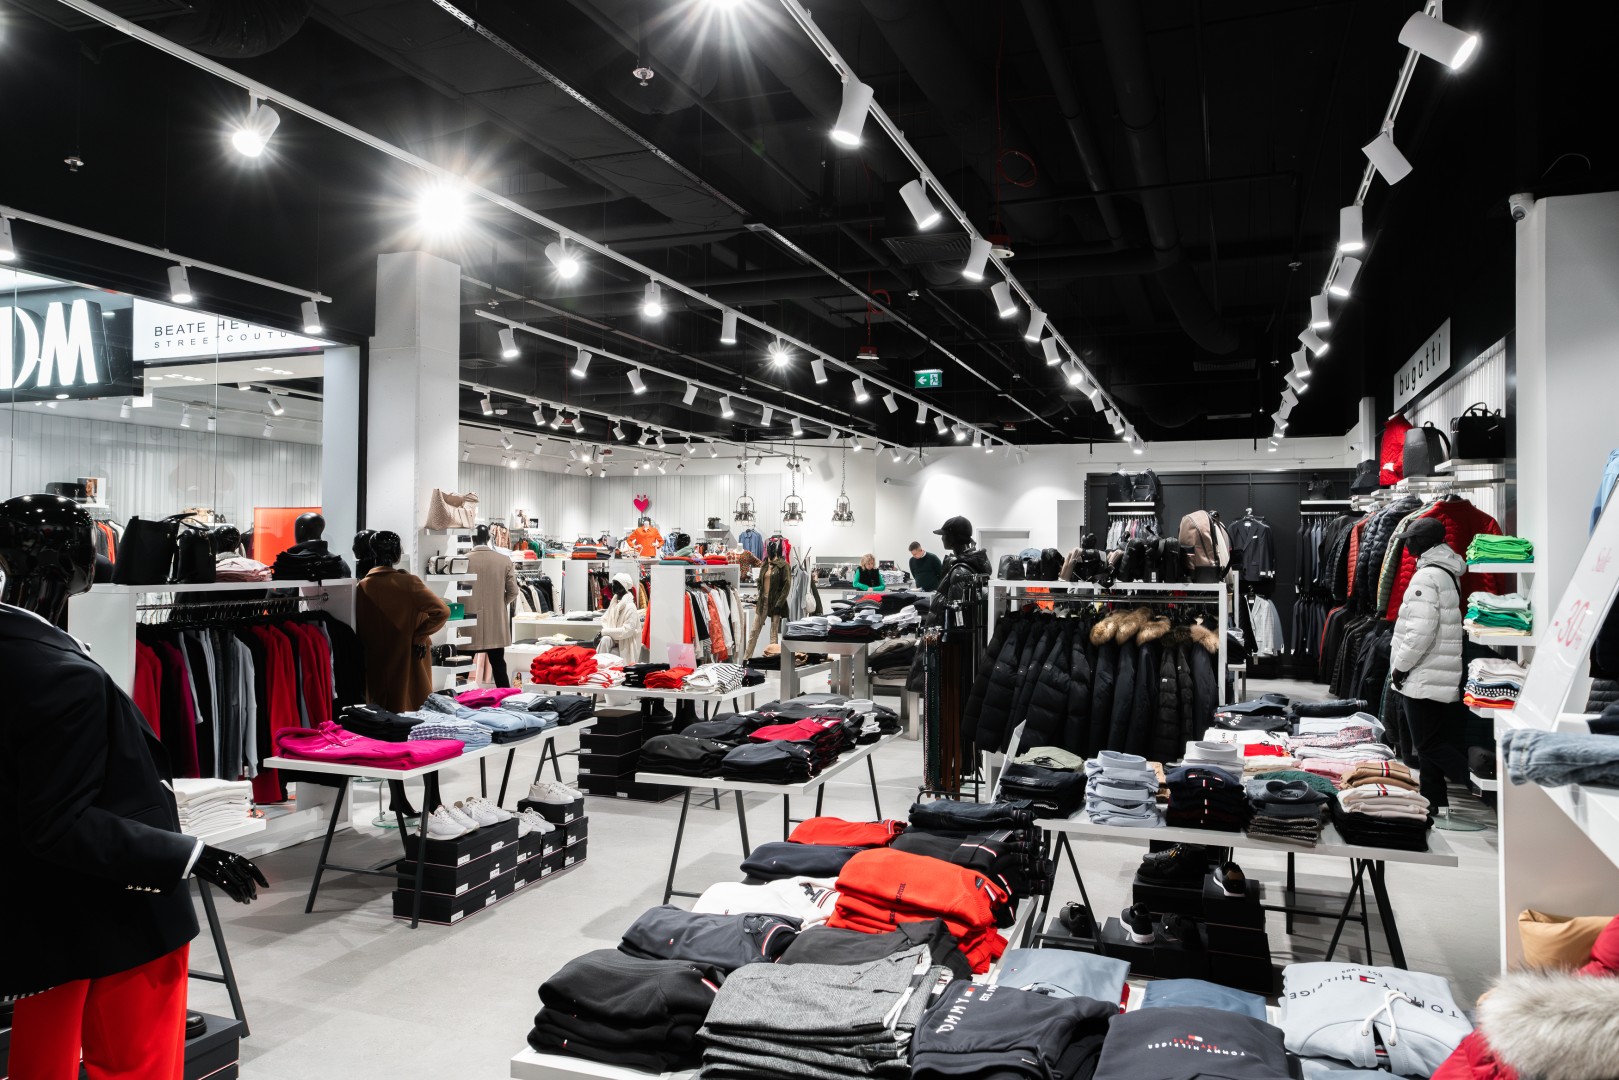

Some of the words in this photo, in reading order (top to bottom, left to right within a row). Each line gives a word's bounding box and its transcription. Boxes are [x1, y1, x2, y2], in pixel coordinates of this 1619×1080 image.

[154, 322, 205, 336] BEATE
[1400, 333, 1441, 396] bugatti
[1383, 982, 1459, 1019] TOMY
